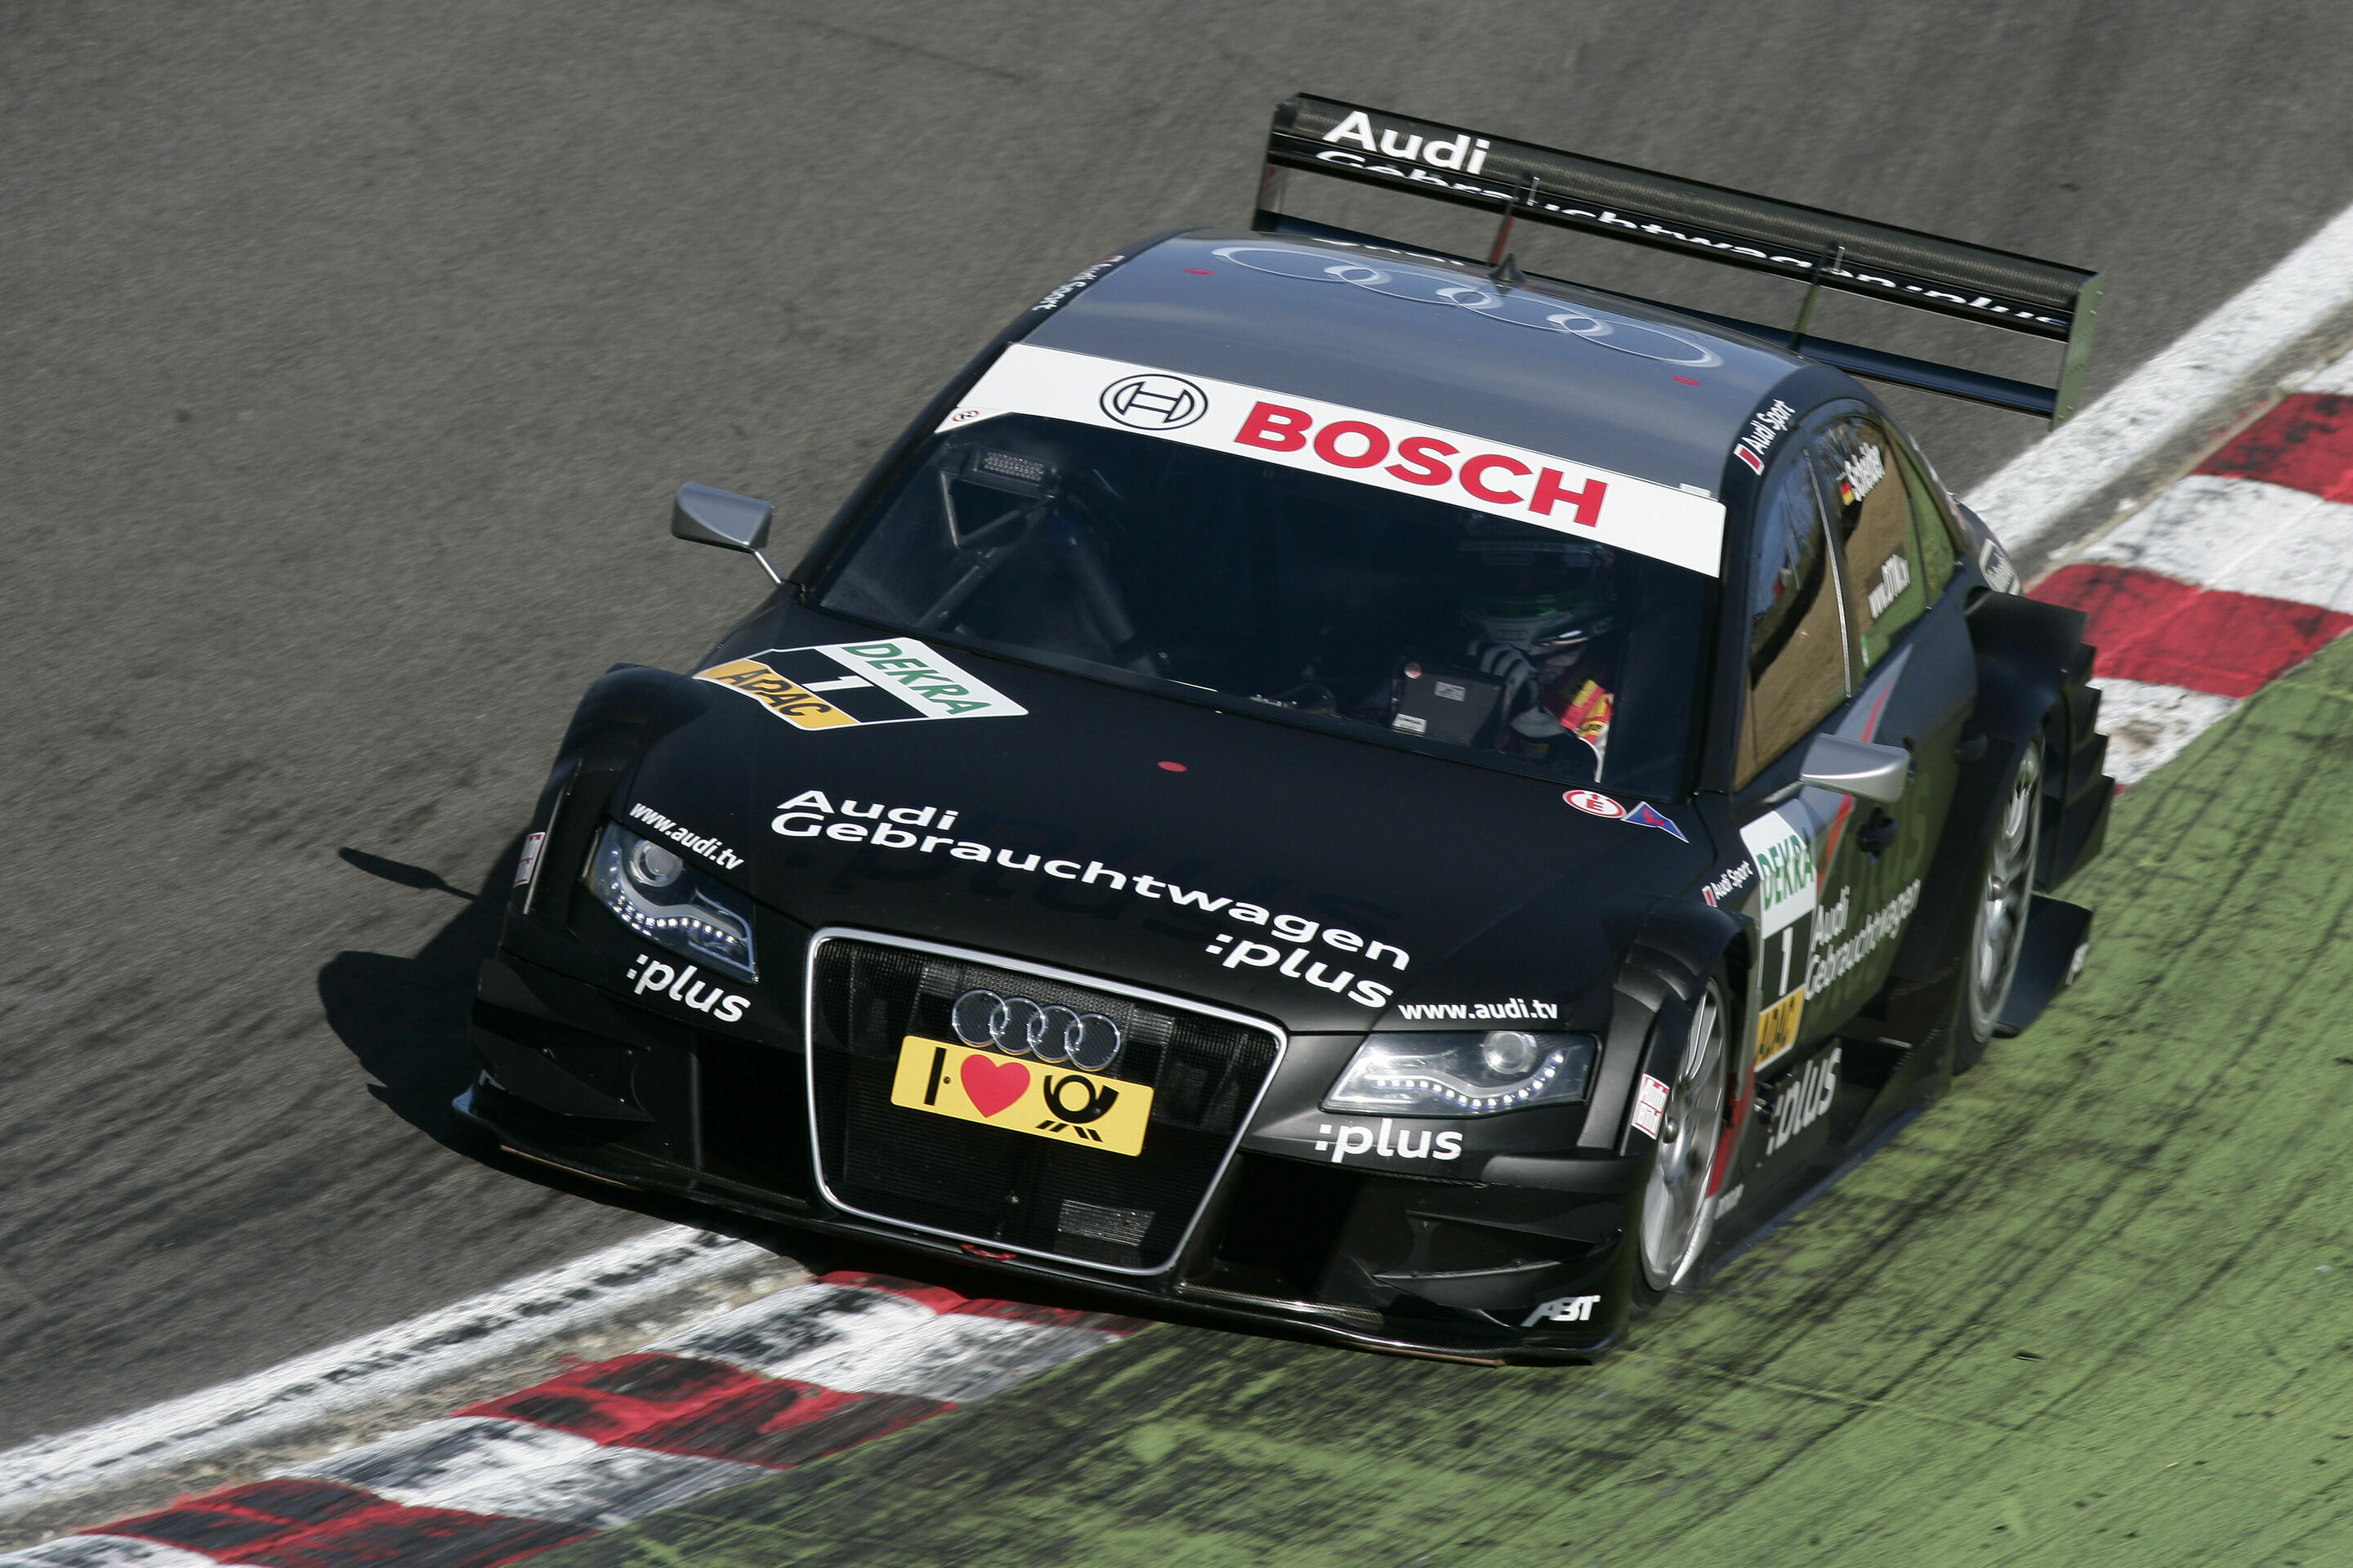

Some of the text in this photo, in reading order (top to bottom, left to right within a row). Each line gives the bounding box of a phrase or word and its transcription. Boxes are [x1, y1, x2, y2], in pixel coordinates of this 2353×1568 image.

[1322, 110, 1491, 176] Audi
[1741, 398, 1796, 455] Audi Sport
[1234, 400, 1609, 527] BOSCH
[718, 668, 833, 717] ADAC
[801, 675, 874, 691] 1
[842, 642, 992, 714] DEKRA
[628, 802, 744, 870] www.audi.tv
[777, 790, 959, 831] Audi
[770, 813, 1411, 971] Gebrauchtwagen
[1710, 860, 1753, 900] Audi Sport
[1756, 828, 1814, 912] DEKRA
[1804, 878, 1921, 1000] Gebrauchtwagen
[1810, 885, 1851, 954] Audi
[626, 954, 752, 1022] :plus
[1203, 931, 1395, 1009] :plus
[1779, 927, 1793, 996] 1
[1398, 998, 1559, 1020] www.audi.tv
[1314, 1118, 1464, 1163] :plus
[1520, 1294, 1601, 1329] ABT
